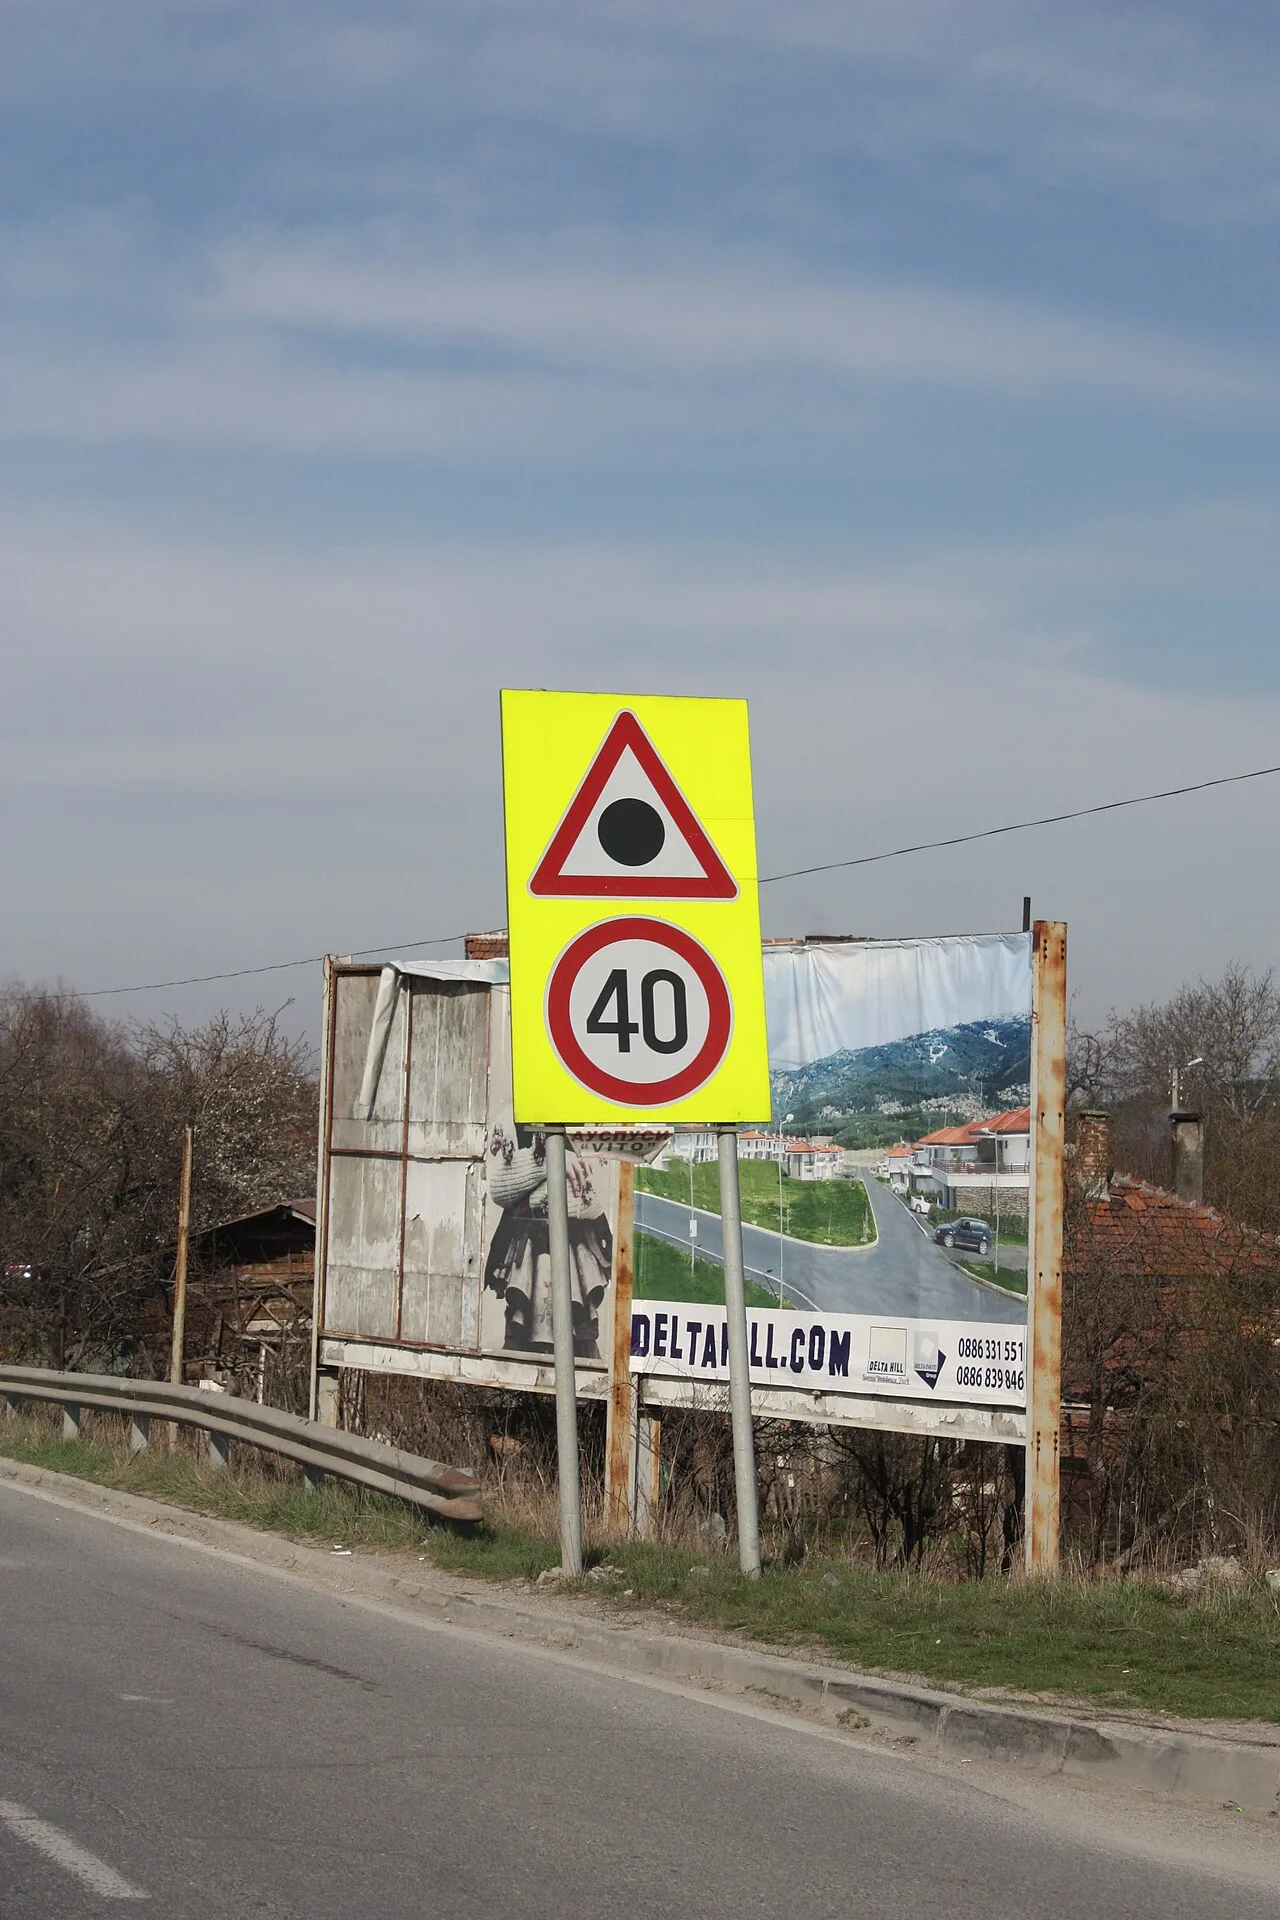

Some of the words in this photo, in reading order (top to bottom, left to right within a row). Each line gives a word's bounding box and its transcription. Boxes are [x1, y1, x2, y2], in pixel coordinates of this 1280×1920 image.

[586, 968, 689, 1055] 40
[571, 1130, 671, 1142] АУСПУСИ
[958, 1337, 984, 1359] 0886
[985, 1339, 1001, 1361] 331
[1004, 1341, 1023, 1363] 551
[869, 1360, 888, 1373] DELTA
[889, 1361, 904, 1374] HILL
[956, 1365, 983, 1388] 0886
[984, 1367, 1004, 1390] 839
[1005, 1369, 1024, 1392] 846
